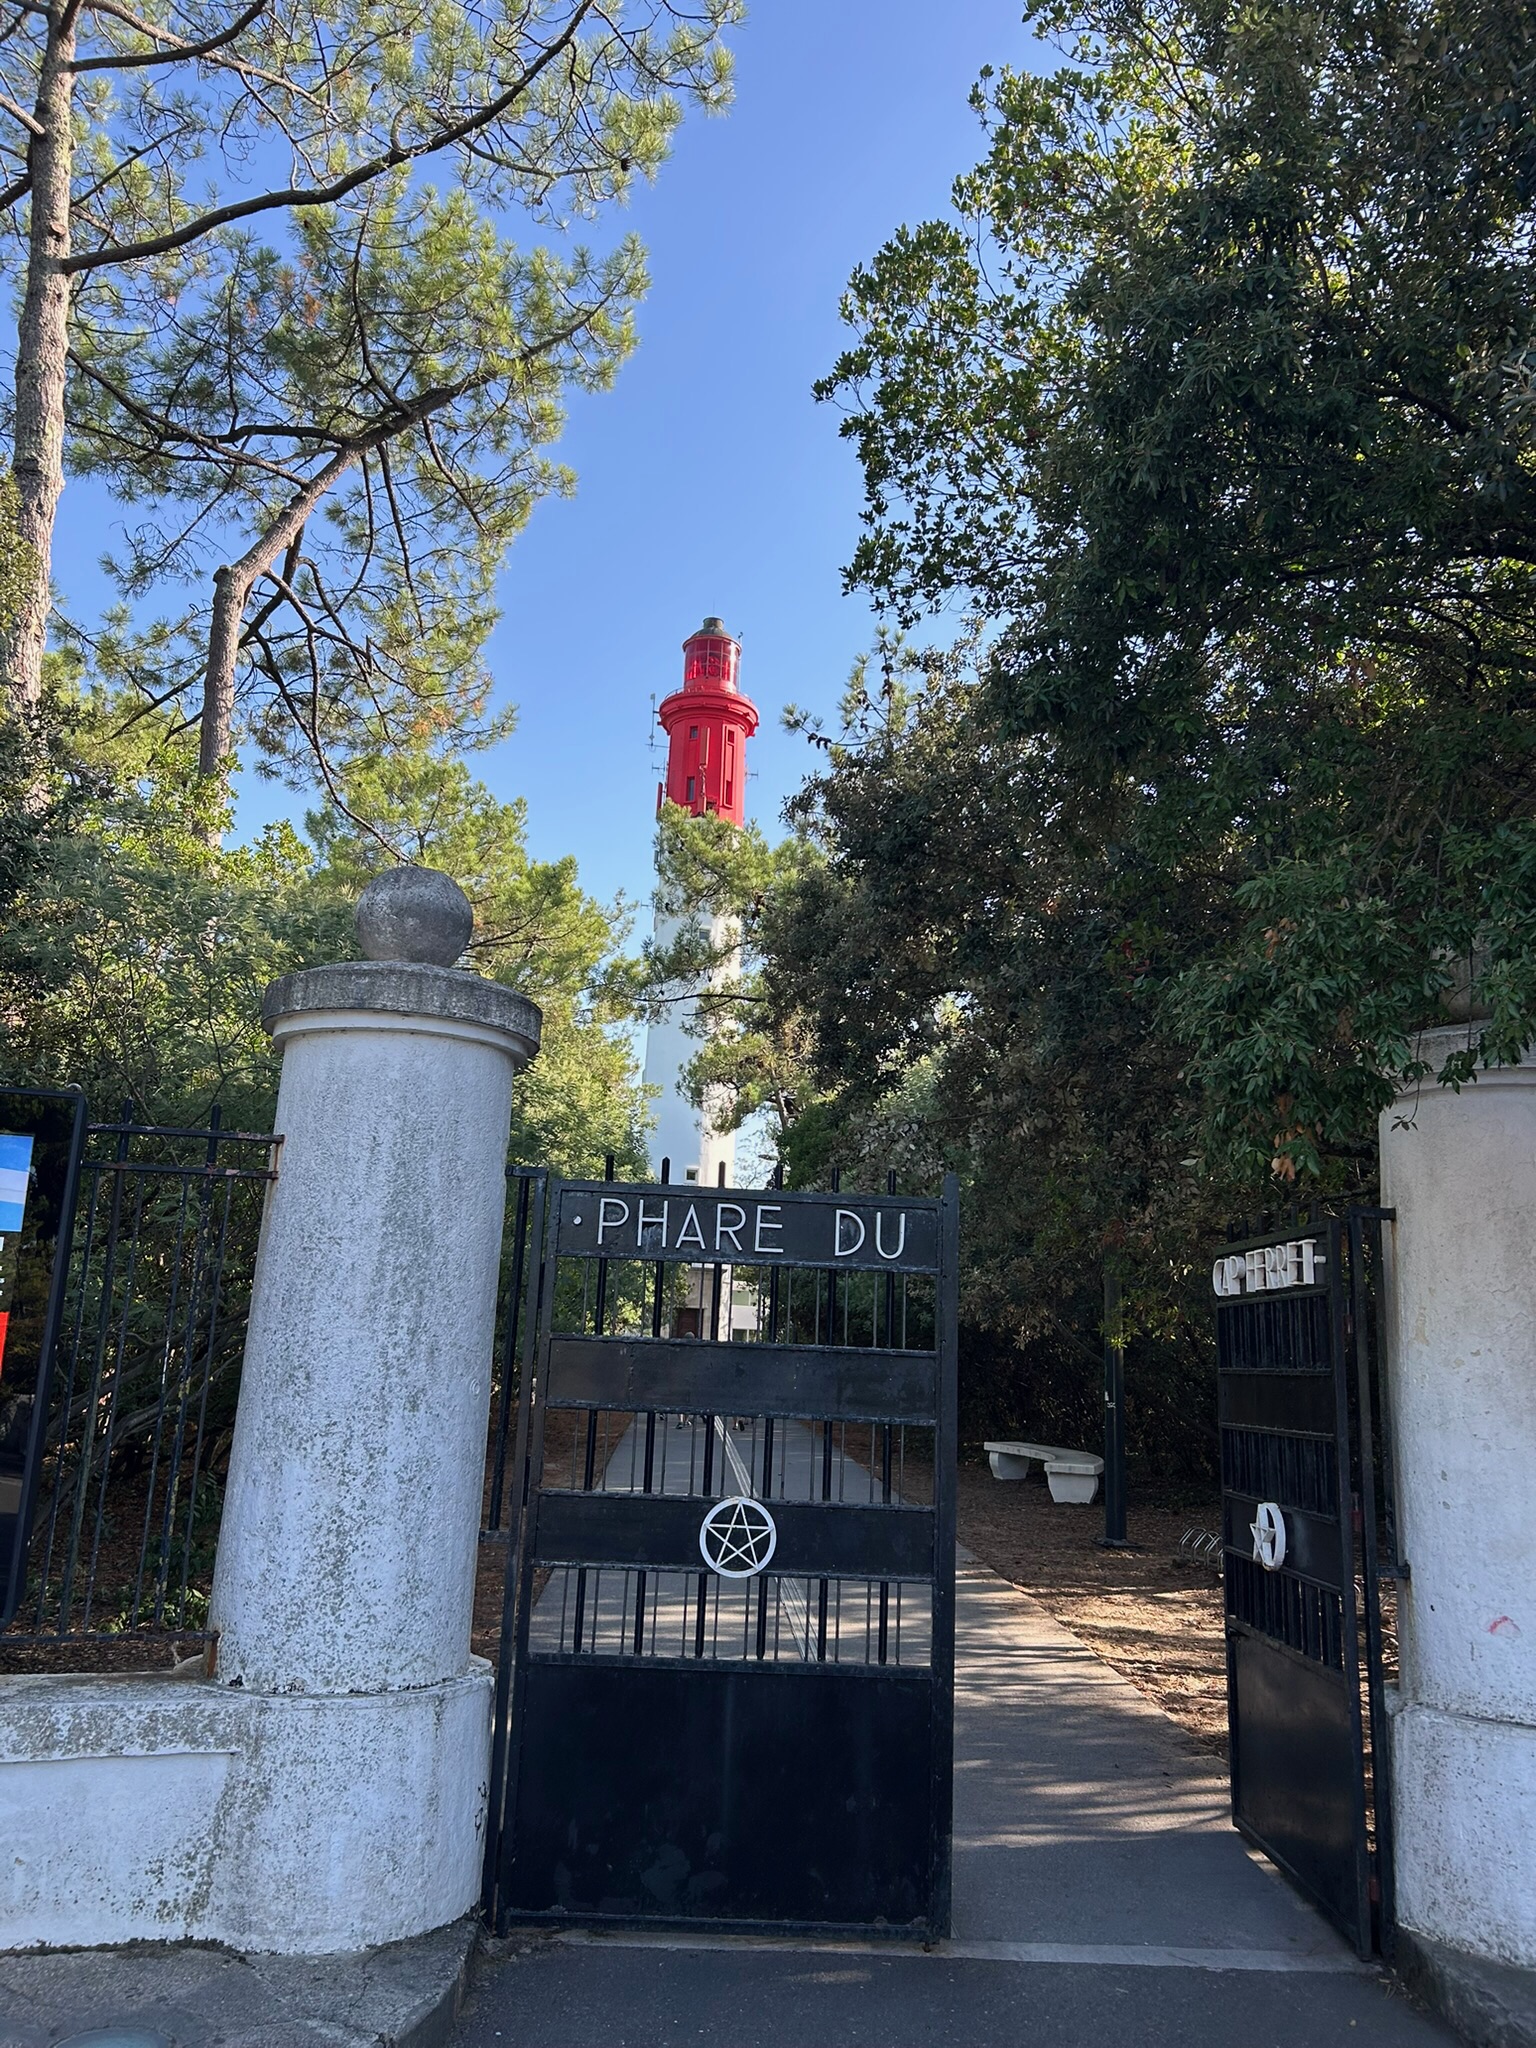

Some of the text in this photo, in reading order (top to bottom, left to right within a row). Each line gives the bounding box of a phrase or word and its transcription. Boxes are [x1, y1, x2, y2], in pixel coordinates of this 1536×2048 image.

[597, 1198, 907, 1260] PHARE DU
[1245, 1238, 1318, 1293] FERRET
